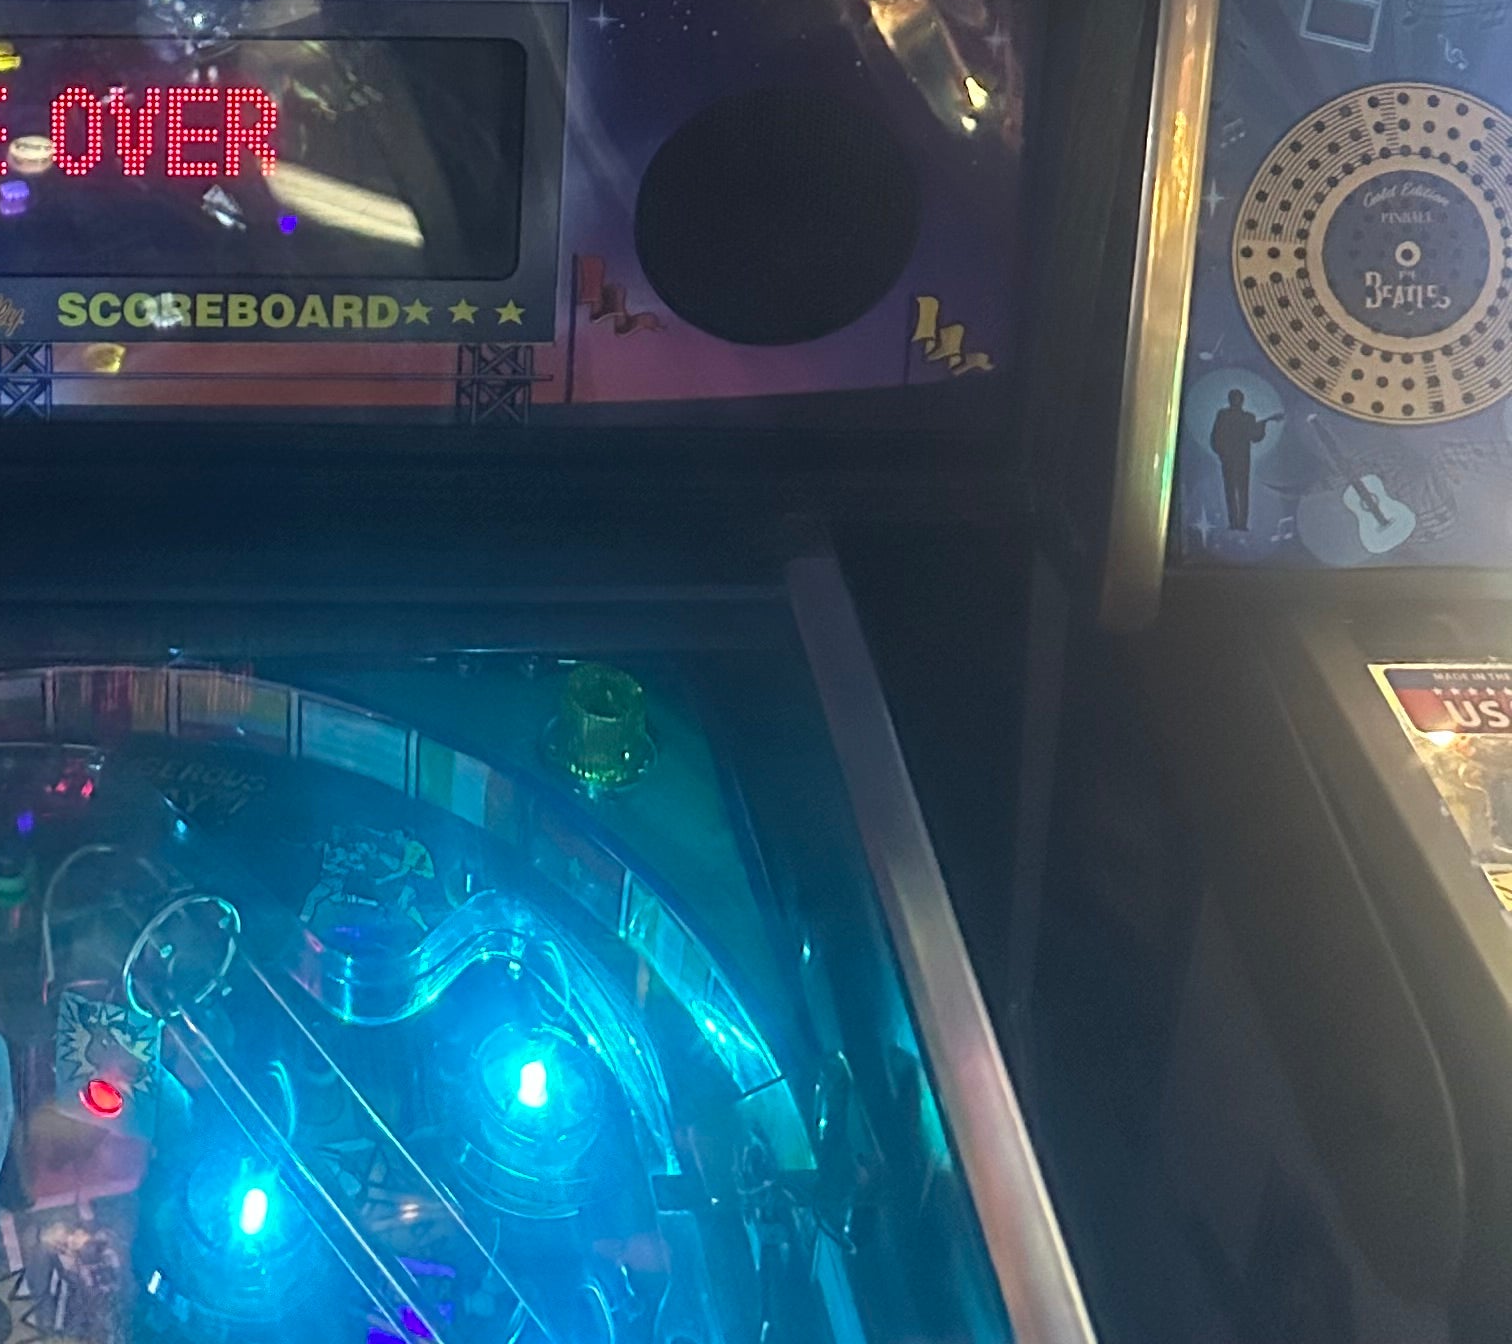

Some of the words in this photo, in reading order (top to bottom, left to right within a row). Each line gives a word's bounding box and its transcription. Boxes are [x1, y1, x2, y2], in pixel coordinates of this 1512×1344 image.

[51, 86, 279, 178] OVER
[1363, 185, 1398, 209] Gold
[1399, 181, 1451, 208] Edition
[1364, 270, 1452, 311] BEATLES
[57, 291, 399, 328] SCOREBOARD
[1471, 672, 1486, 681] IN
[1443, 699, 1512, 728] US
